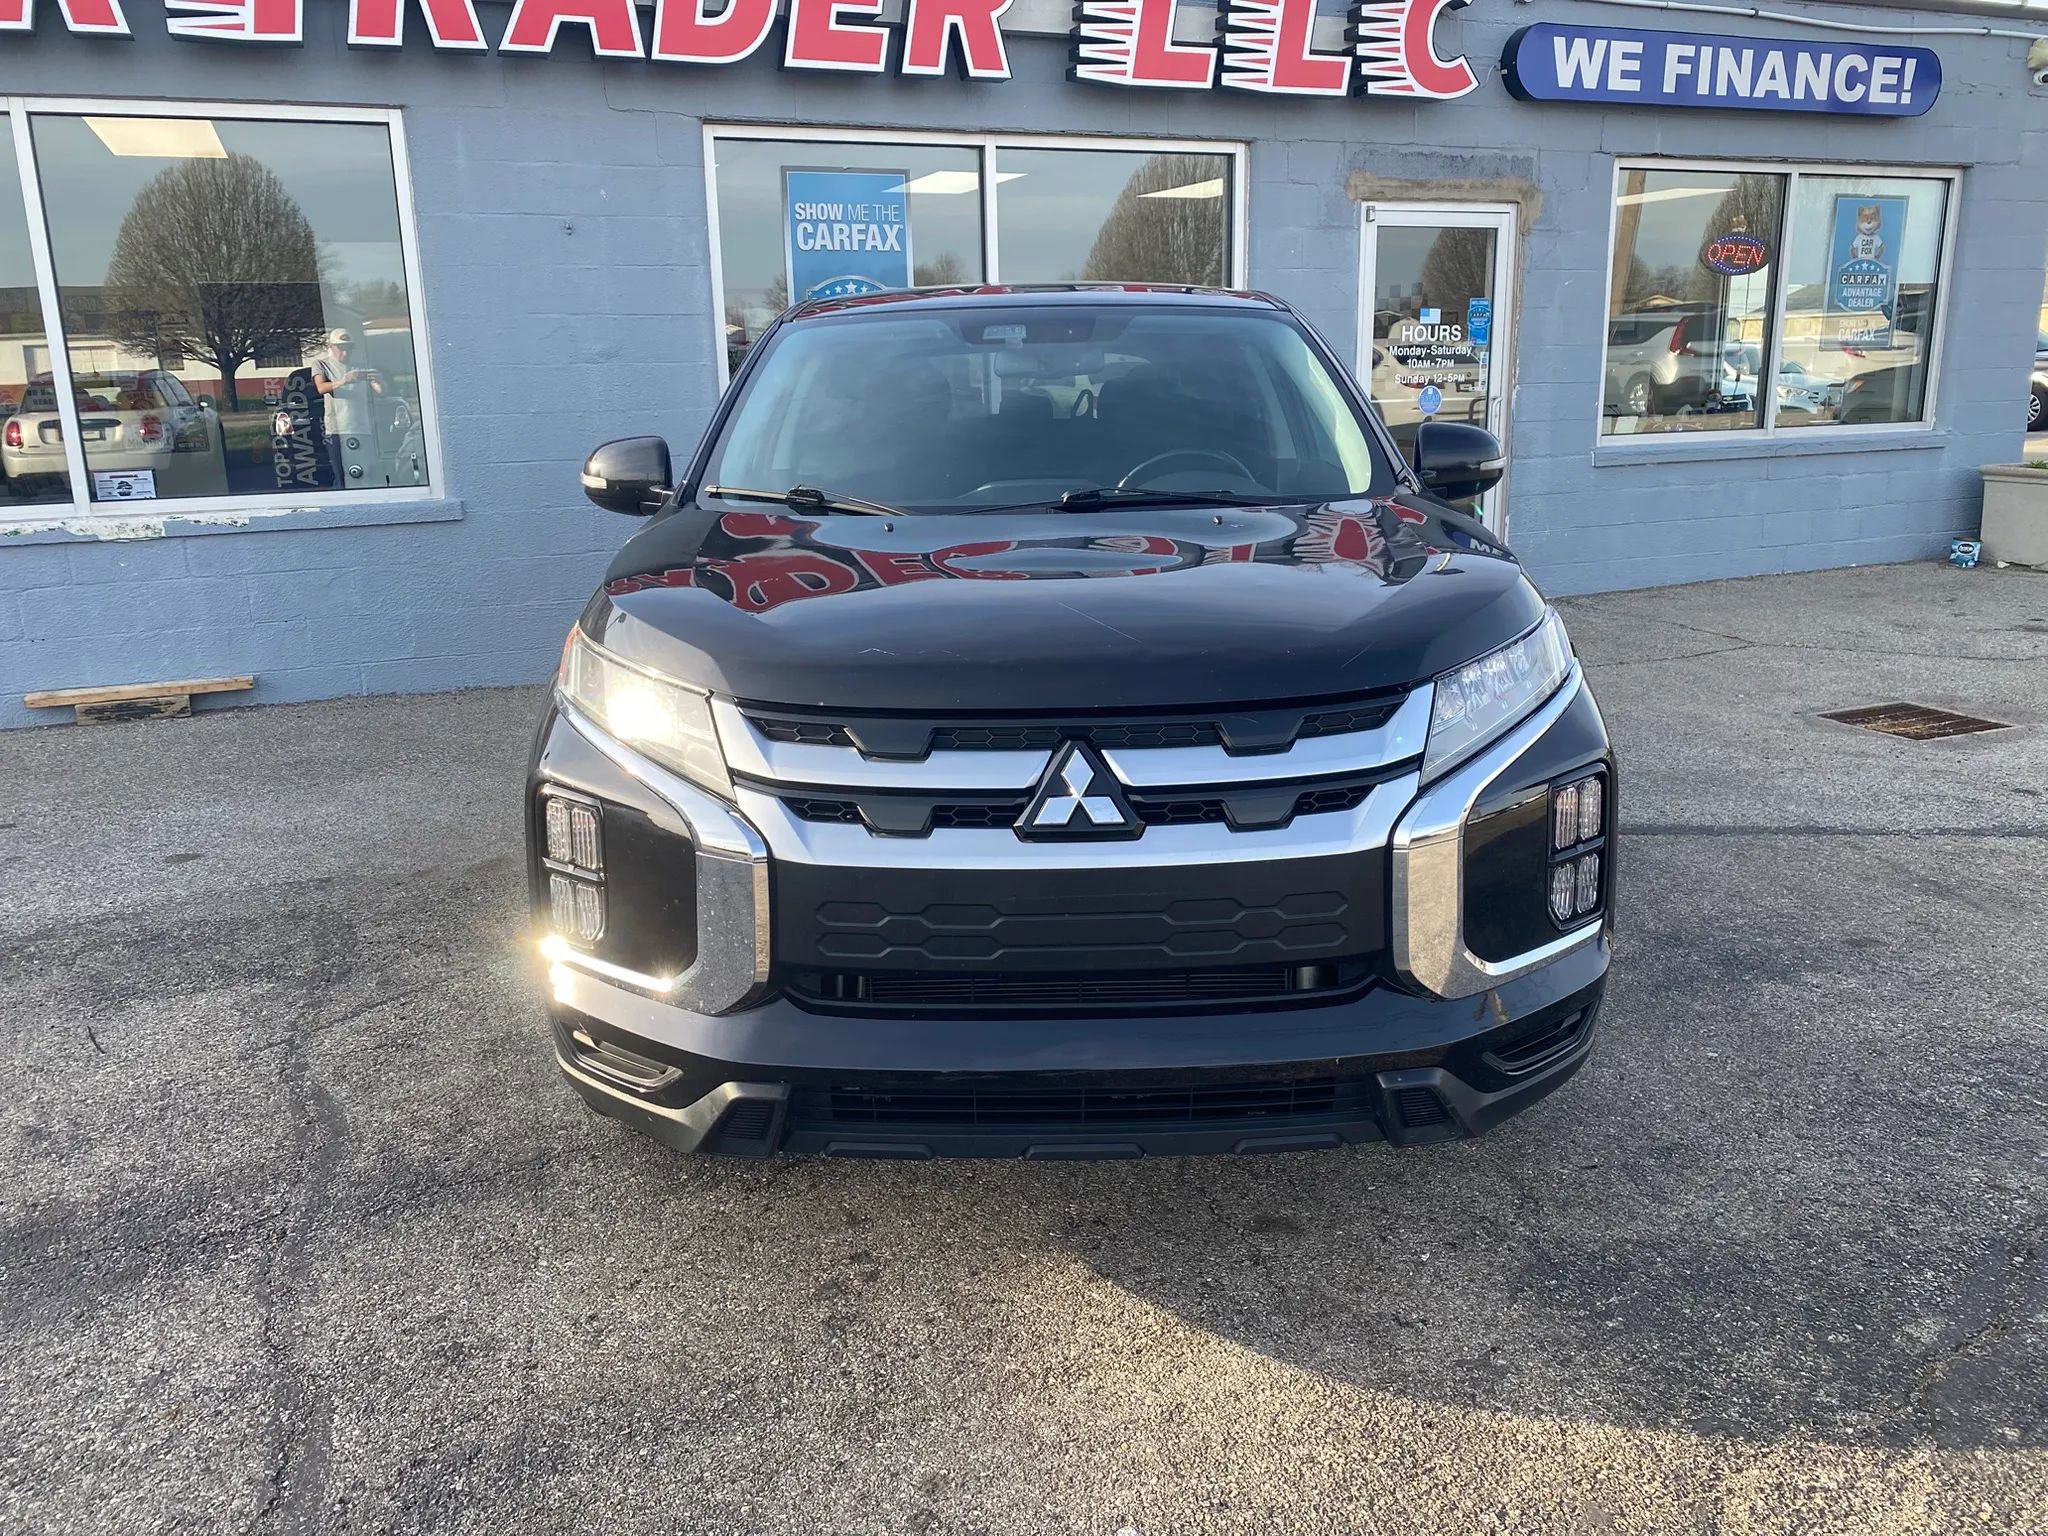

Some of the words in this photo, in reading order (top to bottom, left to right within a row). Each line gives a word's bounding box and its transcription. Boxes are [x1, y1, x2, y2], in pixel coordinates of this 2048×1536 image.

[166, 0, 1013, 80] ADER
[1076, 0, 1480, 100] LLC
[1553, 36, 1644, 92] WE
[1662, 43, 1918, 105] FINANCE!
[795, 203, 843, 220] SHOW
[848, 204, 870, 221] ME
[873, 205, 900, 222] THE
[796, 222, 901, 252] CARFAX
[1861, 239, 1874, 247] CAR
[1707, 243, 1766, 266] OPEN
[1861, 247, 1872, 255] FOX
[1841, 274, 1887, 285] CARFAX
[1841, 287, 1882, 297] ADVANTAGE
[1848, 298, 1874, 308] DEALER
[1401, 325, 1462, 342] HOURS
[1389, 345, 1472, 357] Monday-Saturday
[1394, 374, 1430, 385] Sunday
[264, 379, 289, 449] DER
[287, 376, 319, 486] AWARDS
[274, 452, 293, 488] TOP
